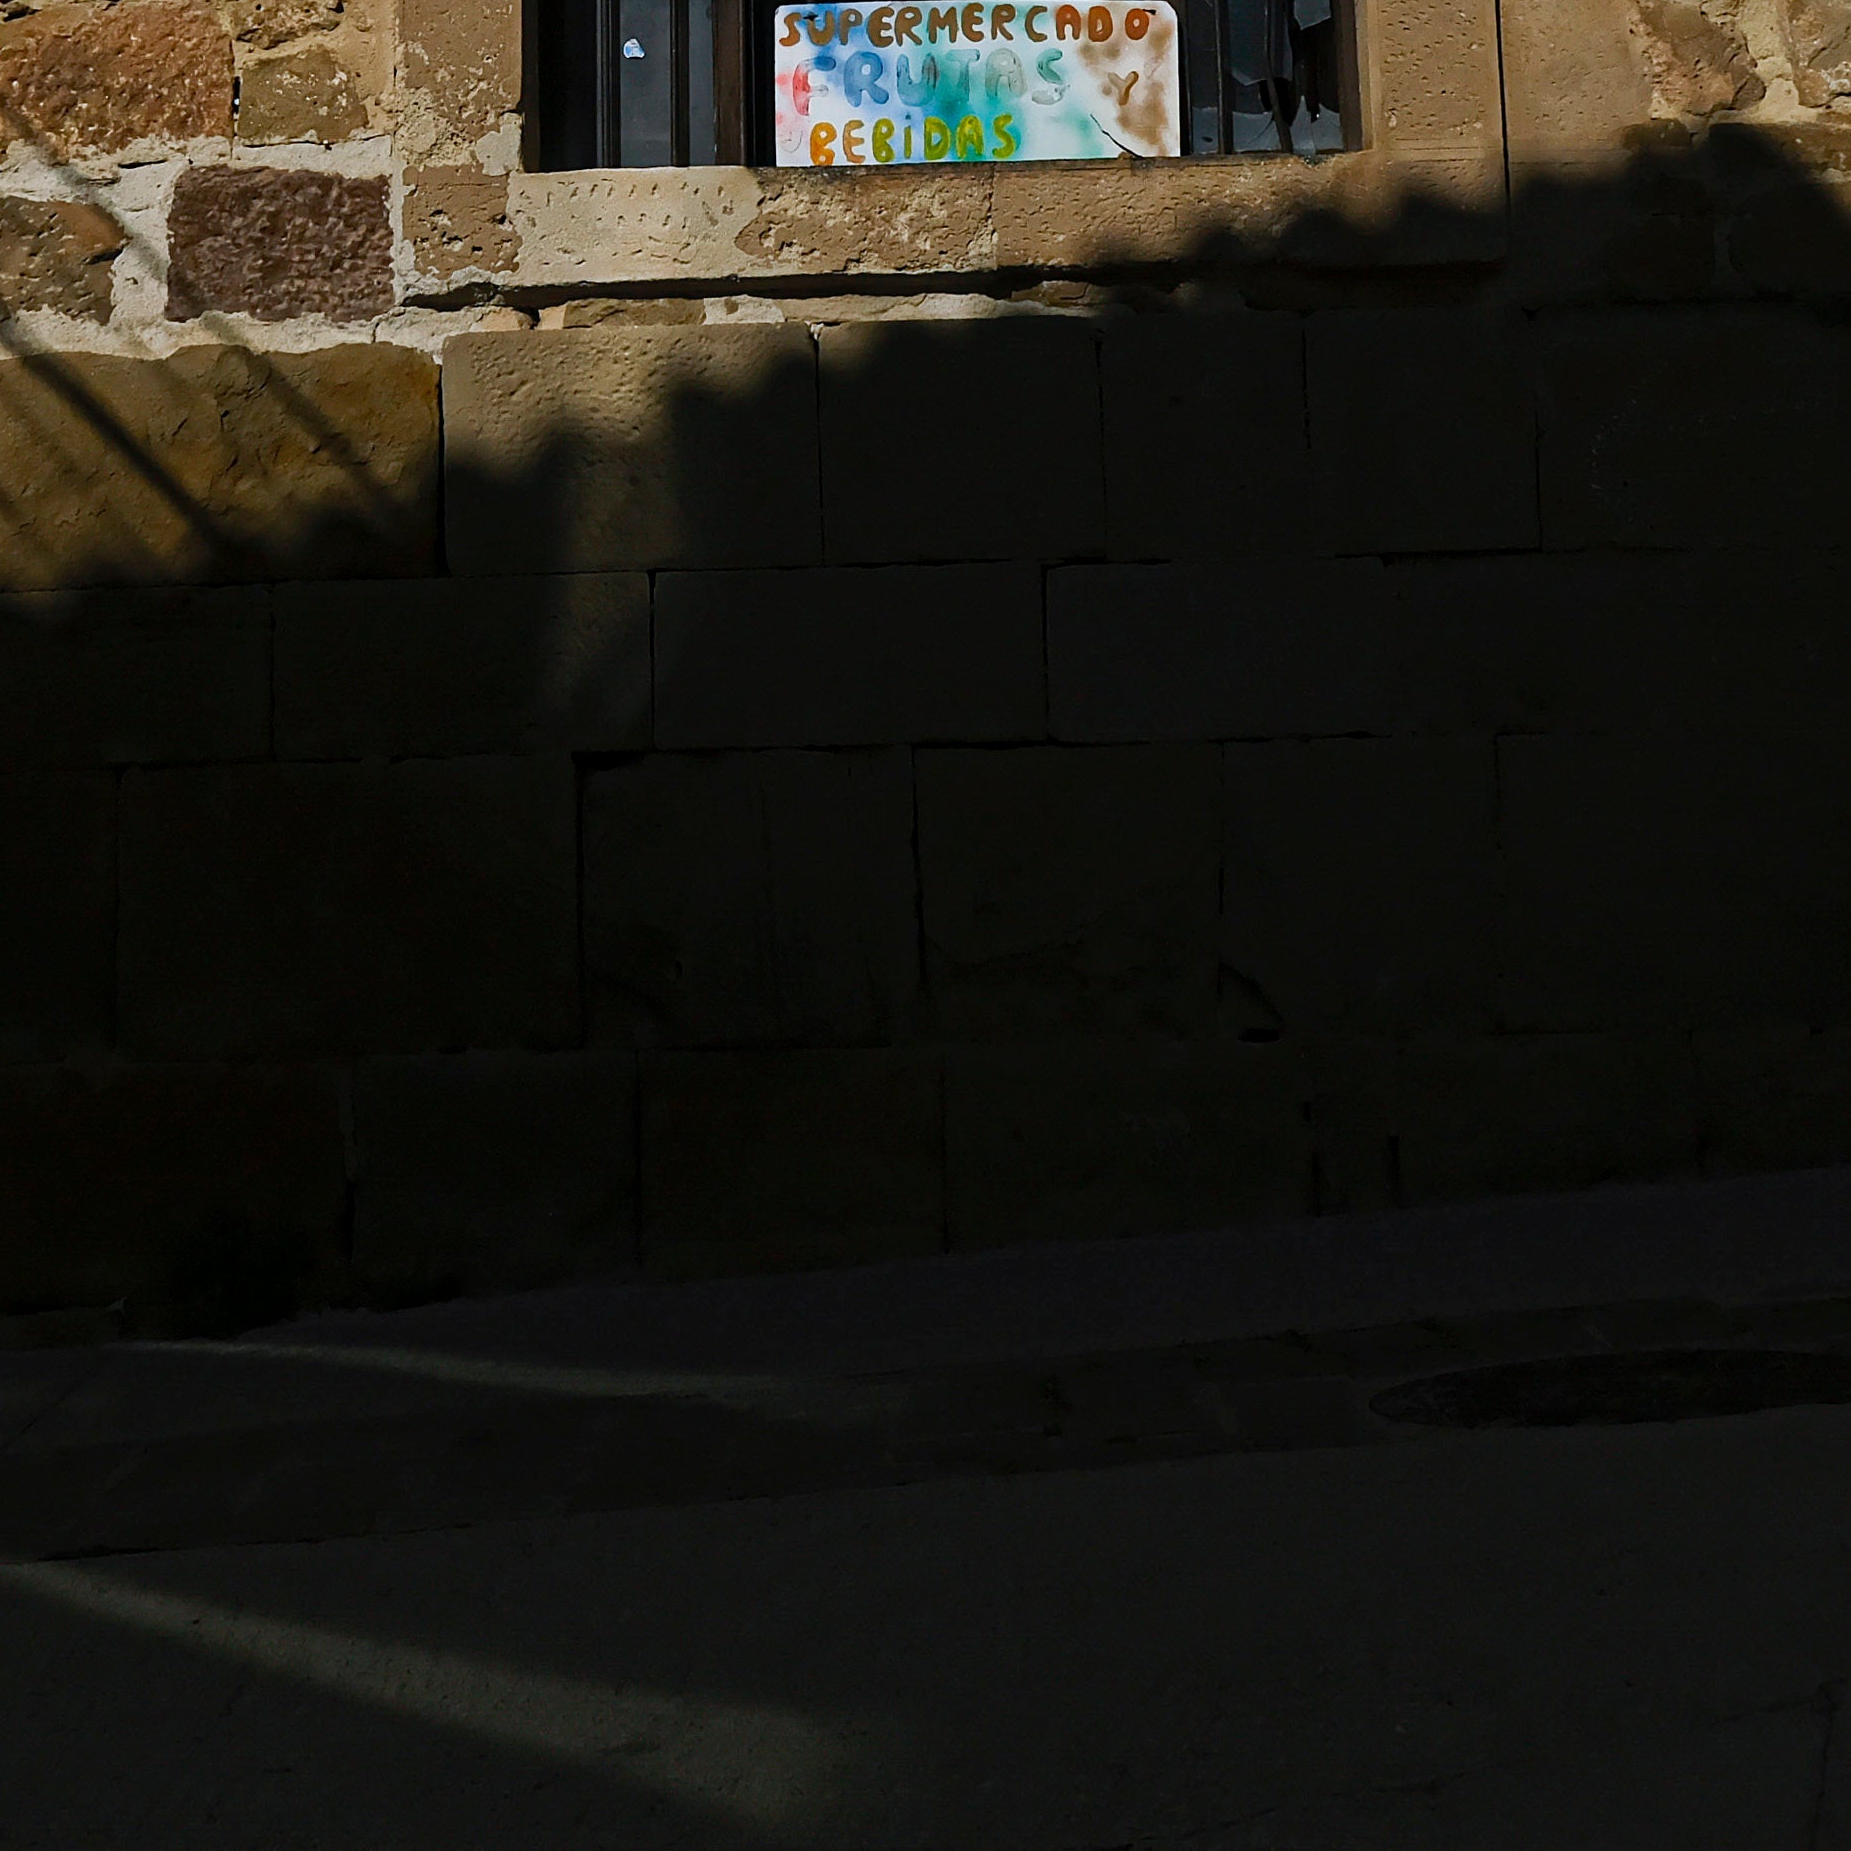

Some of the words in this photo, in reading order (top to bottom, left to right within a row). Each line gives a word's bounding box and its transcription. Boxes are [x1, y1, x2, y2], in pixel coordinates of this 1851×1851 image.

[779, 5, 1150, 47] SUPERMERCADO
[792, 48, 1072, 116] FRUTAS
[1107, 70, 1139, 105] Y
